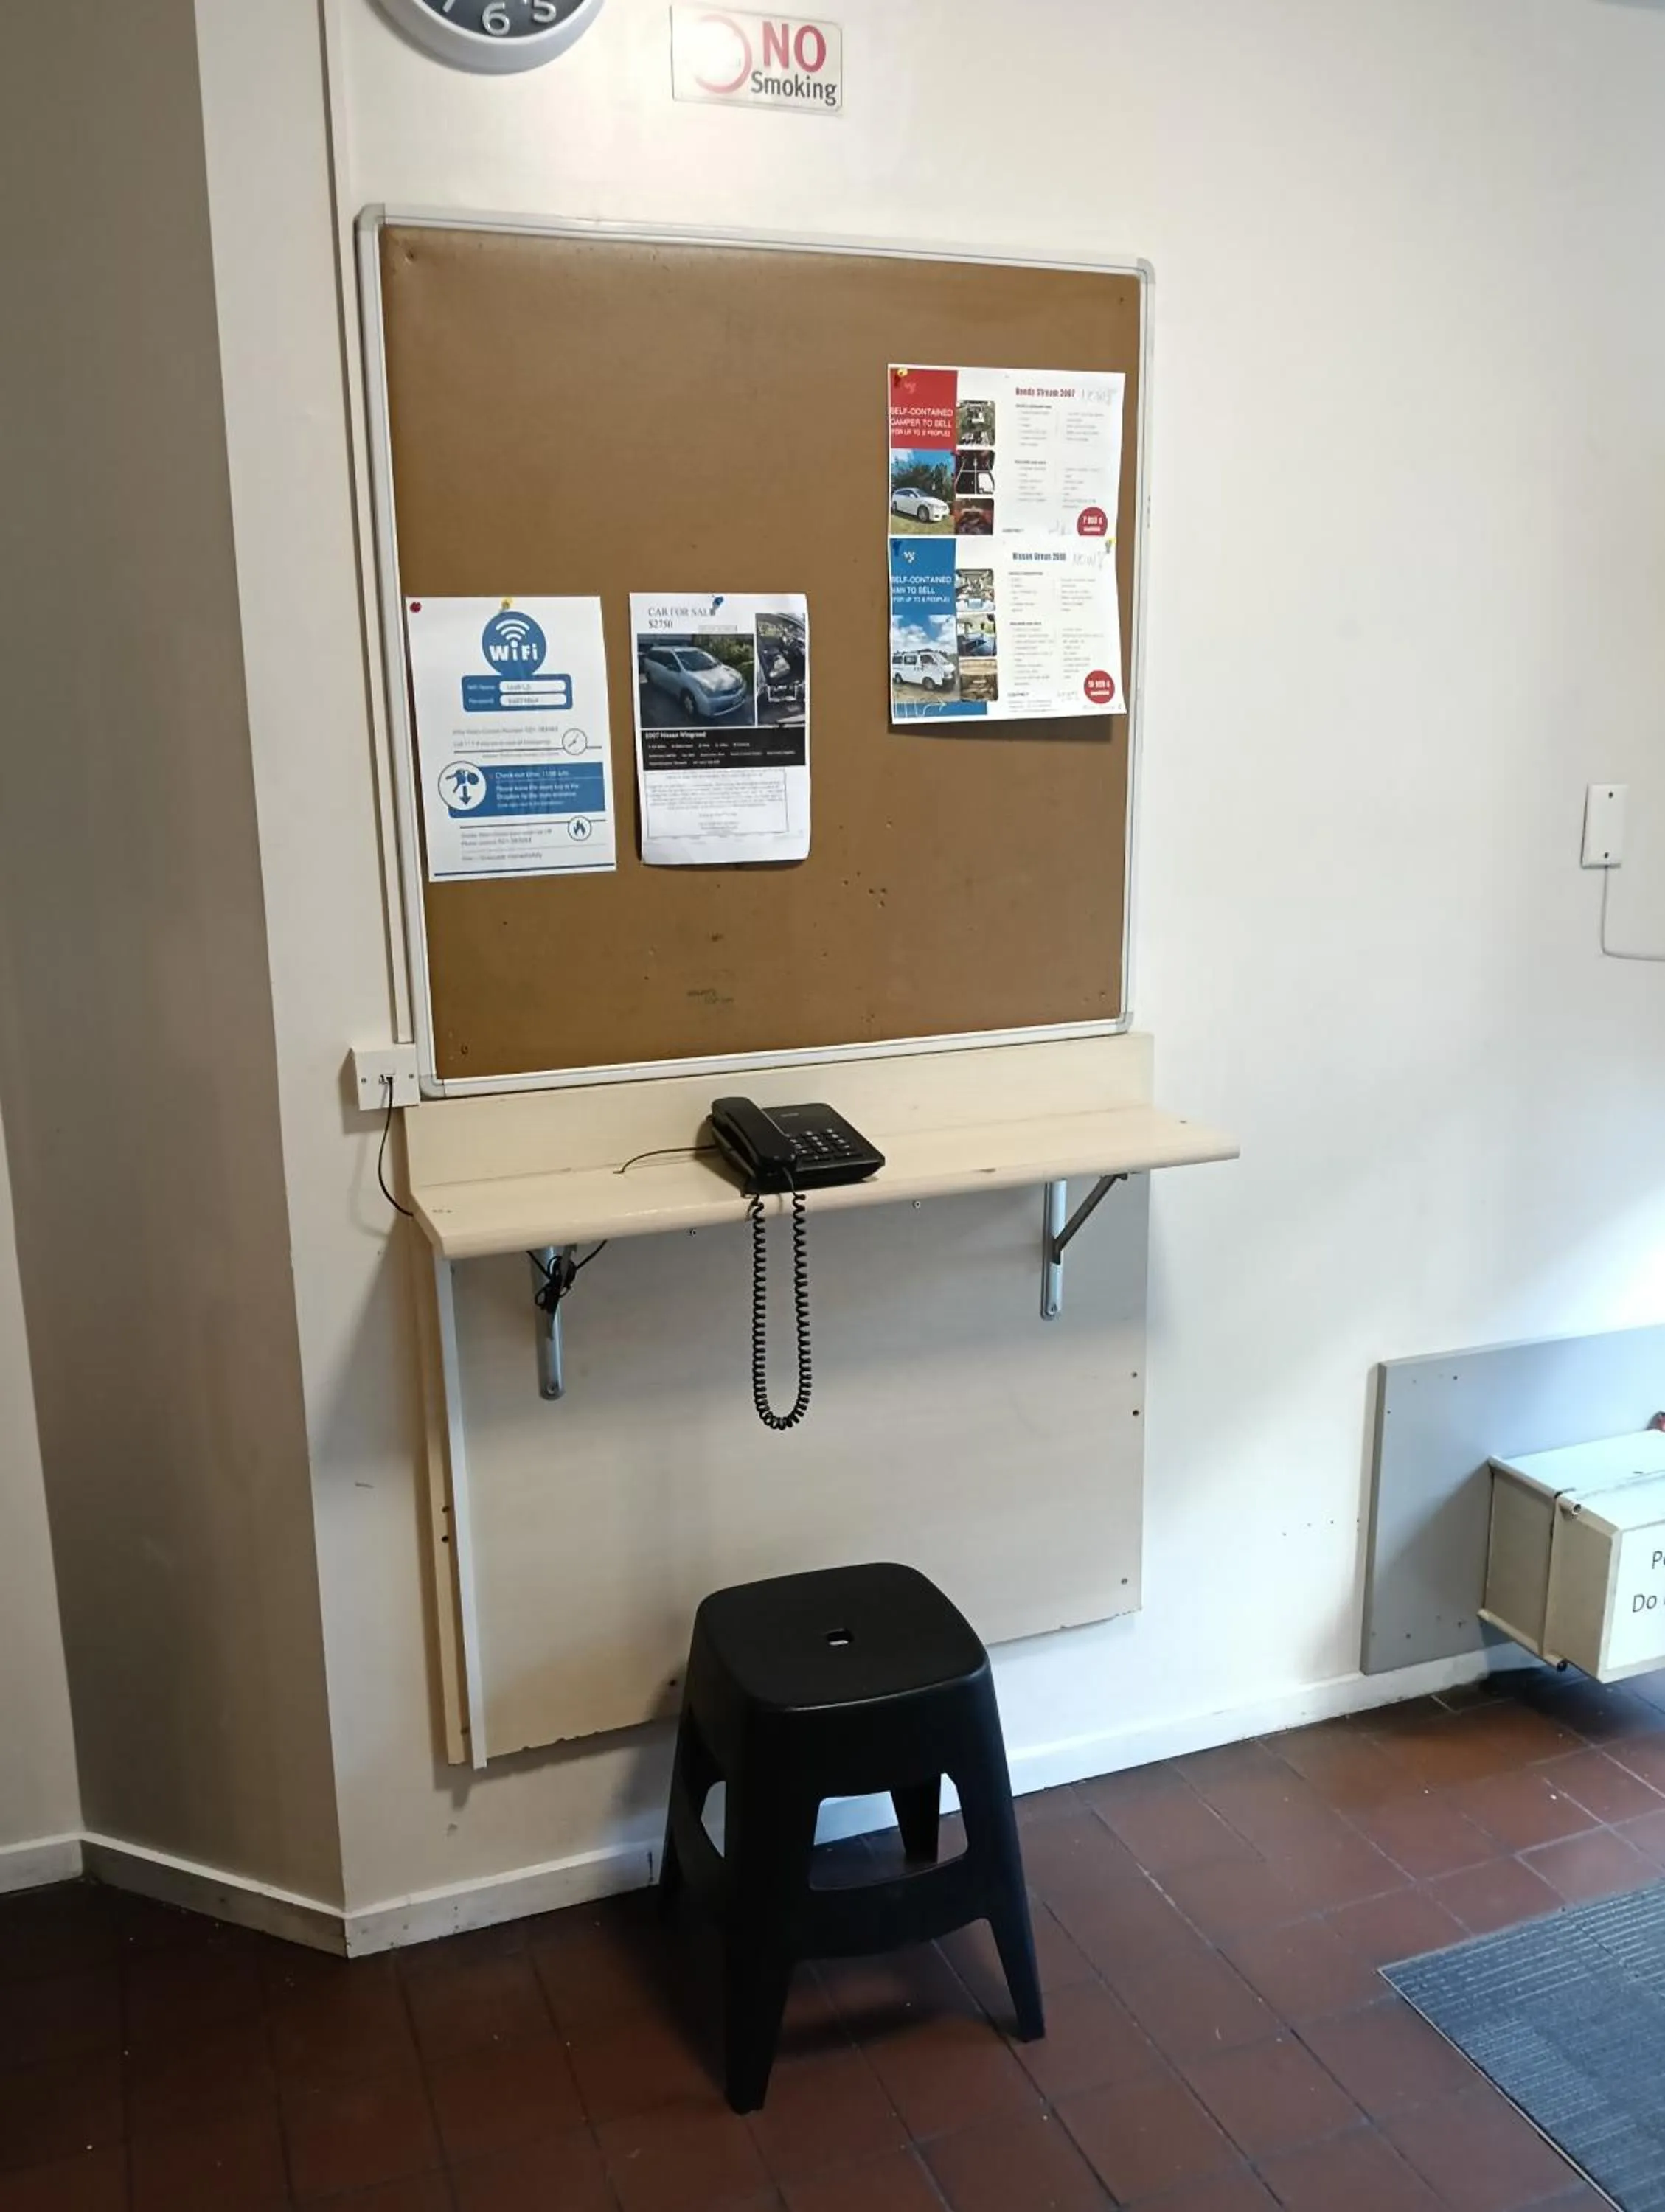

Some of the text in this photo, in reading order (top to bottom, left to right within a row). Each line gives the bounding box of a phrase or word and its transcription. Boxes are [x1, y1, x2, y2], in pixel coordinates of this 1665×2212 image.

[482, 2, 510, 35] 6
[533, 0, 556, 23] 5
[762, 21, 827, 73] NO
[751, 70, 837, 107] Smoking
[1015, 387, 1035, 396] Honda
[1037, 388, 1059, 397] Stream
[922, 418, 933, 427] TO
[934, 418, 952, 428] SELL
[1012, 553, 1033, 561] Nissan
[918, 587, 936, 595] SELL
[648, 608, 670, 616] CAR
[670, 608, 689, 616] FOR
[489, 639, 538, 661] WiFi
[1652, 1551, 1665, 1569] P
[1632, 1593, 1657, 1613] Do
